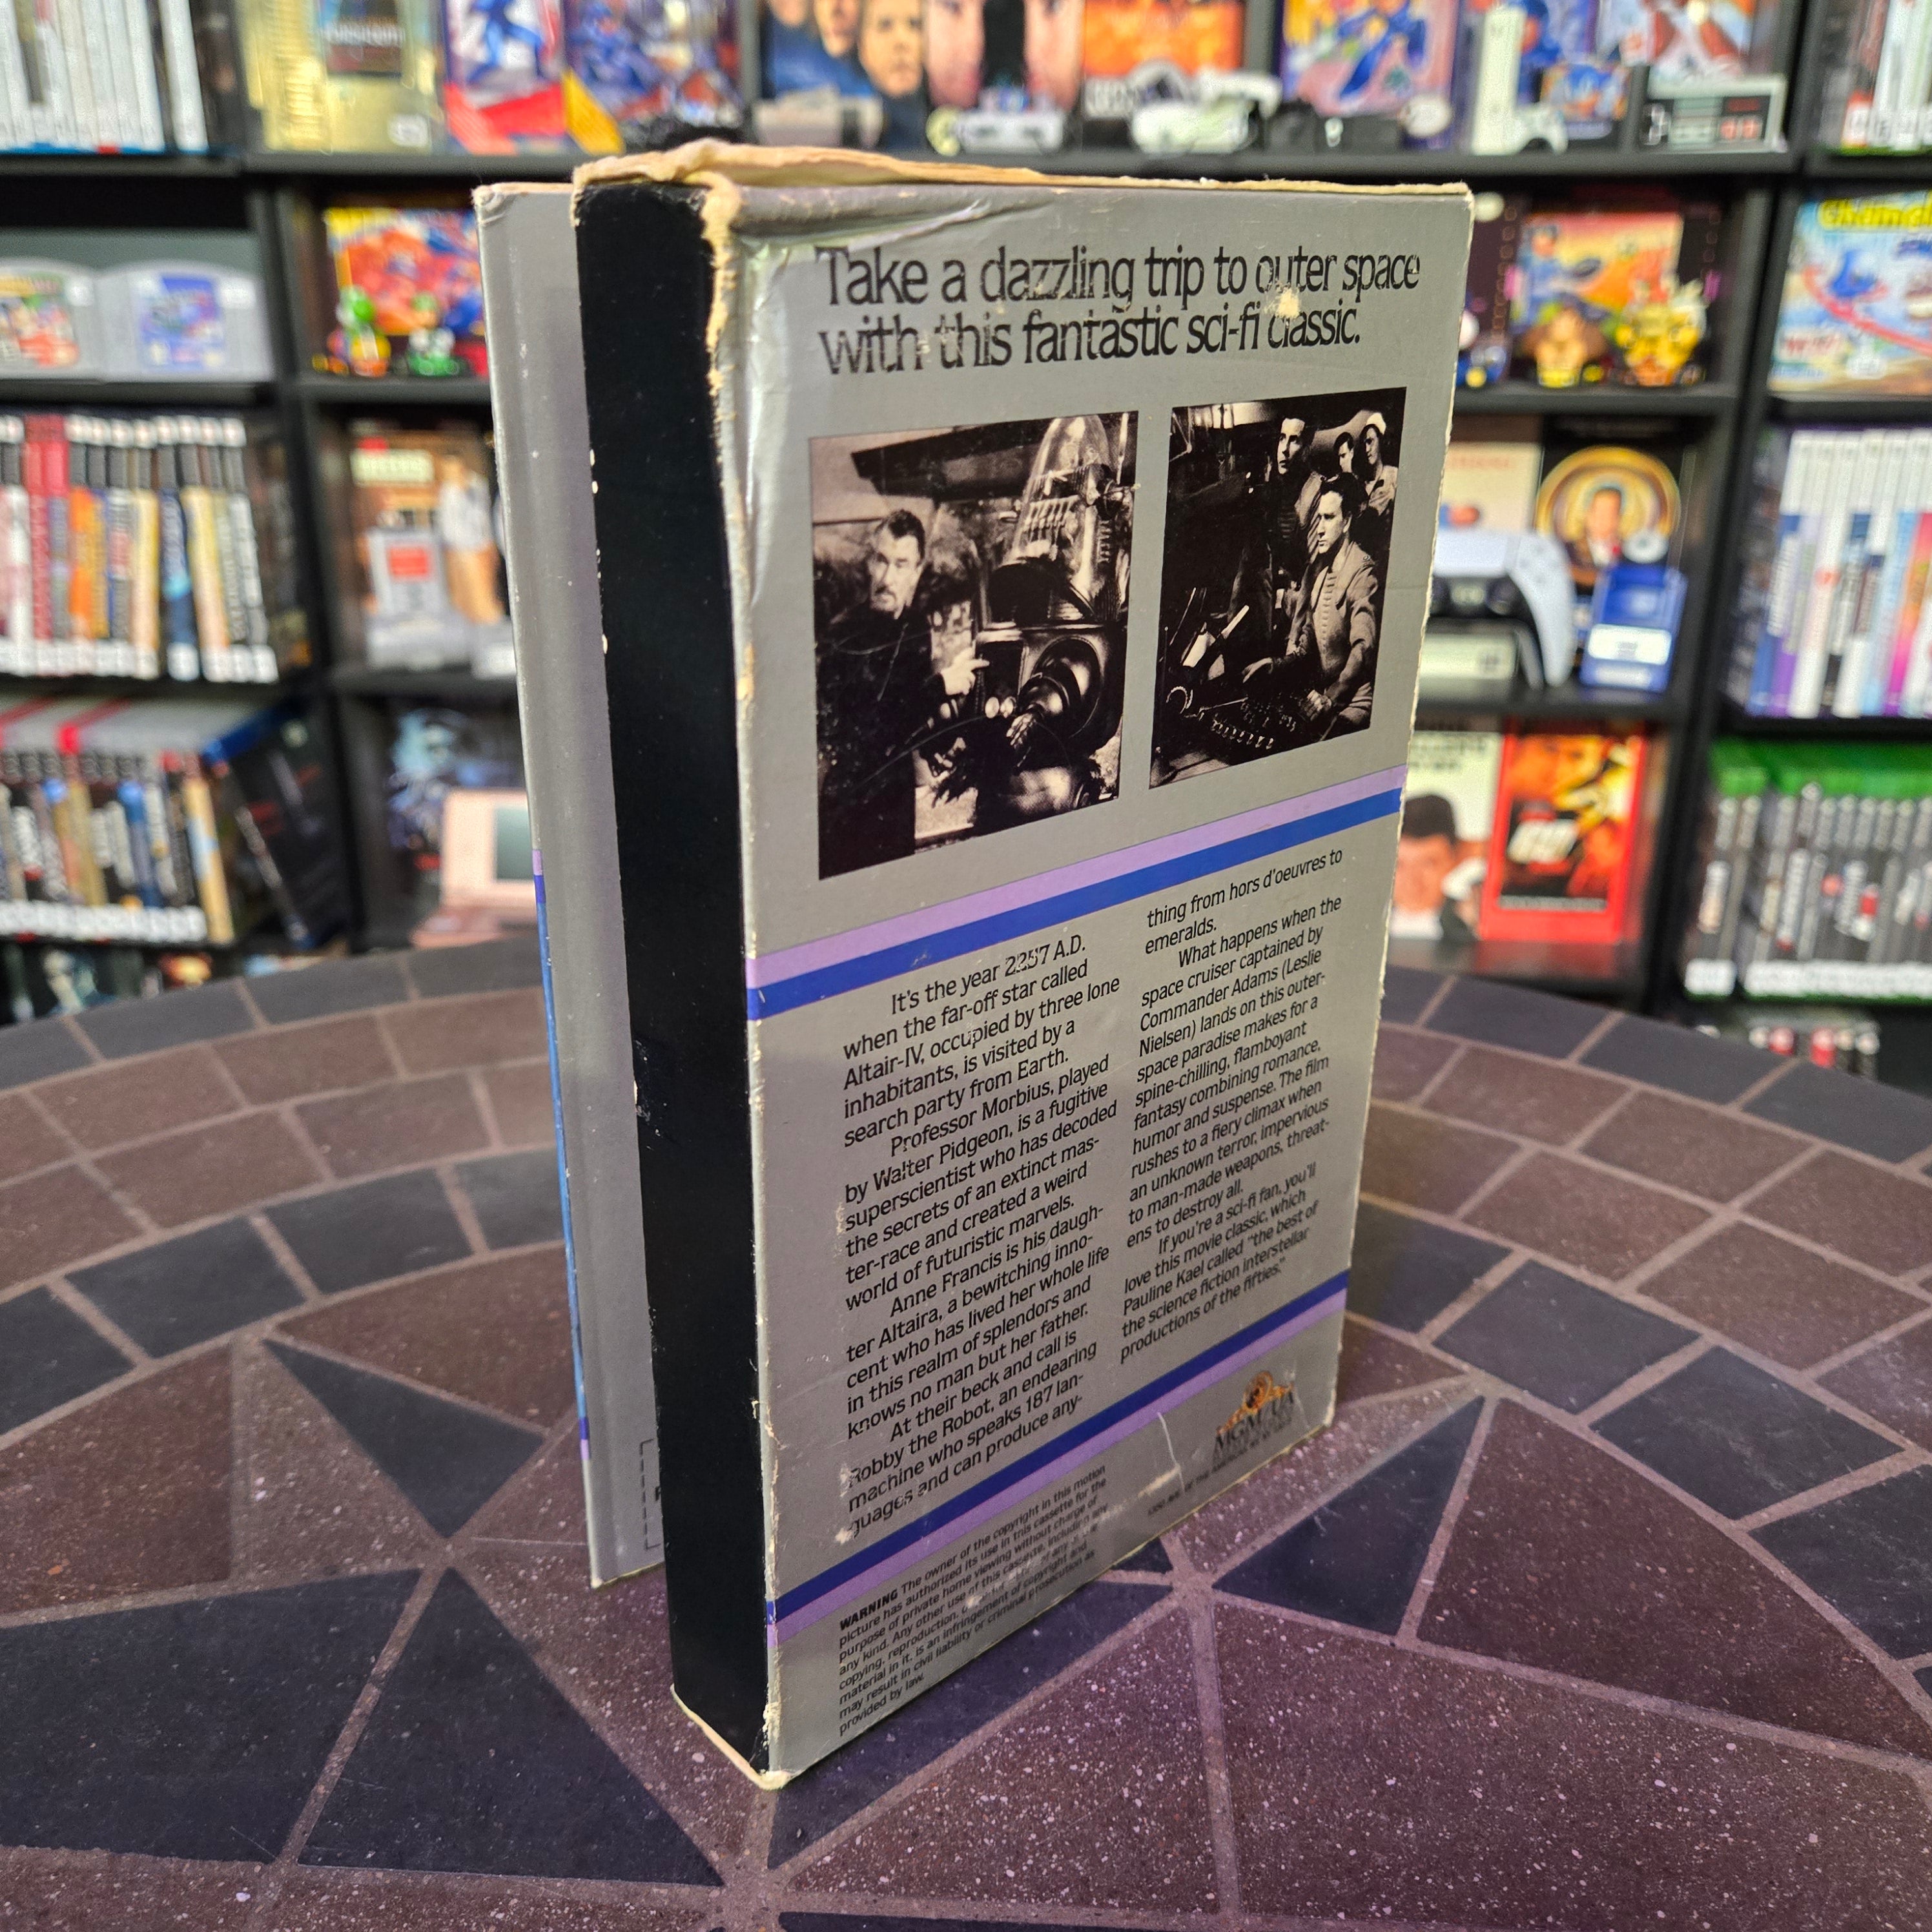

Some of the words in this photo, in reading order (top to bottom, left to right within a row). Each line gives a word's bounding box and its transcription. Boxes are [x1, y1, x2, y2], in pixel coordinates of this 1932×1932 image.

[816, 245, 929, 305] Take
[941, 259, 967, 303] a
[980, 245, 1136, 313] dazzling
[1144, 245, 1205, 310] trip
[1214, 246, 1248, 294] to
[1255, 245, 1337, 294] outer
[1342, 254, 1421, 303] space
[819, 314, 924, 375] with
[934, 313, 1012, 370] this
[1023, 305, 1180, 364] fantastic
[1186, 301, 1261, 355] sci-fi
[1267, 298, 1361, 349] classic.
[1145, 916, 1217, 954] emeralds.
[1147, 902, 1187, 928] thing
[1190, 889, 1225, 914] from
[1229, 877, 1260, 900] hors
[1262, 854, 1326, 888] d'oeuvres
[1329, 848, 1342, 865] to
[1178, 939, 1217, 968] What
[1219, 920, 1277, 953] happens
[1281, 906, 1316, 930] when
[1319, 897, 1341, 916] the
[843, 1028, 898, 1060] when
[903, 1015, 936, 1038] the
[940, 988, 998, 1026] far-off
[1002, 980, 1037, 1005] star
[1040, 958, 1087, 991] called
[892, 989, 920, 1014] It's
[924, 980, 956, 1003] the
[960, 965, 1000, 997] year
[1004, 943, 1051, 977] 2257
[1053, 934, 1085, 961] A.D.
[1139, 1019, 1196, 1057] Nielsen)
[1200, 1005, 1237, 1033] lands
[1239, 998, 1256, 1016] on
[1259, 986, 1284, 1008] this
[1286, 971, 1325, 996] outer-
[1140, 985, 1229, 1032] Commander
[1230, 967, 1278, 996] Adams
[1281, 948, 1321, 980] (Leslie
[1141, 979, 1184, 1009] space
[1187, 959, 1237, 989] cruiser
[1239, 929, 1304, 969] captained
[1307, 925, 1323, 945] by
[843, 1042, 924, 1090] Altair-IV,
[930, 1012, 1009, 1058] occupied
[1014, 1007, 1035, 1030] by
[1038, 991, 1083, 1018] three
[1087, 978, 1120, 1002] lone
[844, 1064, 958, 1118] inhabitants,
[963, 1055, 977, 1074] is
[981, 1029, 1037, 1066] visited
[1042, 1024, 1062, 1046] by
[1065, 1020, 1074, 1035] a
[1135, 1056, 1229, 1108] spine-chilling,
[1233, 1020, 1307, 1065] flamboyant
[1136, 1054, 1178, 1084] space
[1181, 1028, 1240, 1069] paradise
[1243, 1009, 1287, 1038] makes
[1290, 1000, 1308, 1018] for
[1310, 996, 1318, 1009] a
[844, 1107, 908, 1147] search
[914, 1087, 965, 1125] party
[969, 1070, 1012, 1098] from
[1017, 1047, 1068, 1080] Earth.
[890, 1109, 977, 1157] Professor
[981, 1080, 1054, 1121] Morbius,
[1058, 1053, 1109, 1095] played
[1131, 1145, 1178, 1179] rushes
[1182, 1138, 1197, 1155] to
[1199, 1133, 1208, 1147] a
[1211, 1116, 1242, 1141] fiery
[1244, 1096, 1285, 1125] climax
[1288, 1080, 1322, 1105] when
[1133, 1096, 1187, 1131] fantasy
[1189, 1065, 1259, 1106] combining
[1133, 1122, 1181, 1155] humor
[1183, 1105, 1209, 1131] and
[1212, 1081, 1276, 1119] suspense.
[1279, 1068, 1302, 1087] The
[1305, 1056, 1329, 1076] film
[845, 1160, 976, 1231] superscientist
[979, 1146, 1015, 1173] who
[1020, 1132, 1047, 1156] has
[1052, 1098, 1116, 1142] decoded
[845, 1232, 878, 1257] the
[883, 1200, 949, 1242] secrets
[953, 1186, 972, 1209] of
[975, 1180, 996, 1200] an
[1000, 1150, 1057, 1189] extinct
[1061, 1136, 1099, 1163] mas-
[1129, 1183, 1147, 1202] an
[1151, 1152, 1213, 1191] unknown
[1260, 1097, 1329, 1140] impervious
[845, 1240, 920, 1284] ter-race
[925, 1217, 957, 1249] and
[962, 1187, 1026, 1231] created
[1030, 1186, 1040, 1200] a
[1043, 1160, 1087, 1194] weird
[845, 1271, 898, 1311] world
[903, 1260, 922, 1284] of
[925, 1226, 1004, 1275] futuristic
[1009, 1195, 1074, 1236] marvels.
[890, 1283, 936, 1317] Anne
[942, 1251, 1002, 1292] Francis
[1006, 1243, 1018, 1261] is
[1023, 1231, 1045, 1253] his
[1049, 1205, 1104, 1239] daugh-
[846, 1337, 875, 1362] ter
[878, 1308, 942, 1349] Altaira,
[947, 1298, 957, 1313] a
[962, 1252, 1051, 1307] bewitching
[1054, 1235, 1093, 1261] inno-
[839, 1588, 898, 1631] WARNING
[900, 1576, 921, 1594] The
[924, 1554, 957, 1580] owner
[960, 1543, 971, 1559] of
[973, 1534, 991, 1551] the
[992, 1504, 1039, 1539] copyright
[1042, 1498, 1051, 1510] in
[1053, 1486, 1071, 1503] this
[839, 1616, 880, 1649] picture
[883, 1602, 902, 1620] has
[905, 1564, 961, 1606] authorized
[981, 1544, 998, 1560] use
[1001, 1537, 1009, 1548] in
[1076, 1489, 1088, 1502] for
[1091, 1477, 1106, 1493] the
[839, 1627, 885, 1664] purpose
[888, 1615, 899, 1631] of
[901, 1594, 939, 1625] private
[942, 1574, 971, 1598] home
[974, 1549, 1011, 1578] viewing
[1014, 1524, 1051, 1553] without
[1087, 1494, 1097, 1508] of
[839, 1698, 863, 1720] may
[867, 1674, 898, 1701] result
[901, 1667, 910, 1680] in
[913, 1651, 932, 1671] civil
[936, 1628, 971, 1658] liability
[974, 1619, 985, 1632] or
[987, 1591, 1026, 1623] criminal
[1028, 1557, 1082, 1599] prosecution
[839, 1694, 887, 1737] provided
[889, 1686, 902, 1701] by
